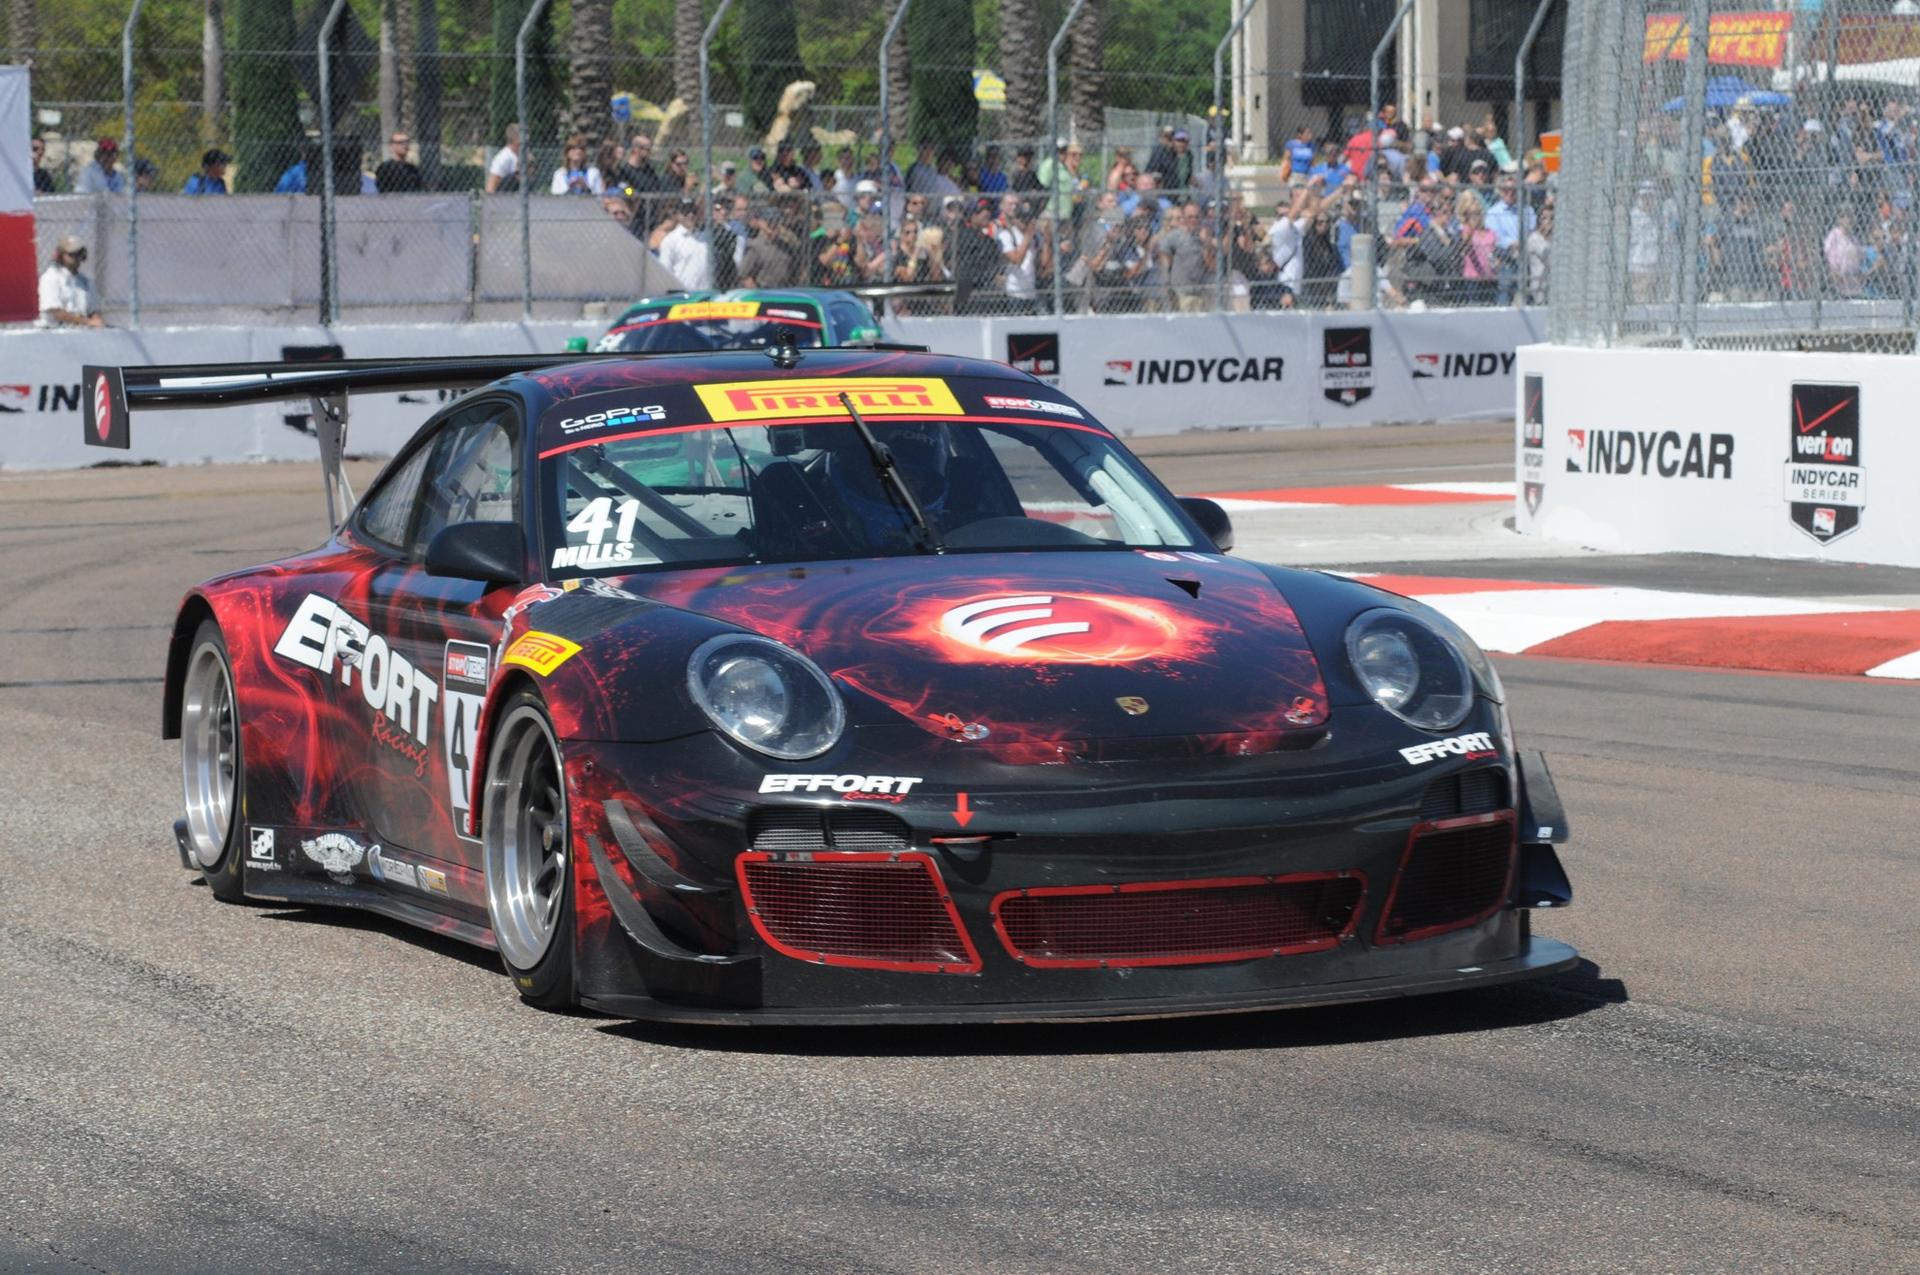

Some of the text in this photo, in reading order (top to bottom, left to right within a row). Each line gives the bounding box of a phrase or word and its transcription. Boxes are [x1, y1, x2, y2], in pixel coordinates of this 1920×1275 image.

[1137, 357, 1284, 385] INDYCAR
[1443, 352, 1516, 378] INDY
[724, 384, 934, 412] PIRELLI
[560, 405, 664, 429] GoPro
[1588, 430, 1735, 480] INDYCAR
[1796, 430, 1853, 462] verizon
[1792, 469, 1859, 488] INDYCAR
[1803, 488, 1848, 501] SERIES
[566, 496, 640, 545] 41
[551, 542, 634, 569] MILLS
[1398, 731, 1496, 765] EFFORT
[757, 774, 923, 794] EFFORT
